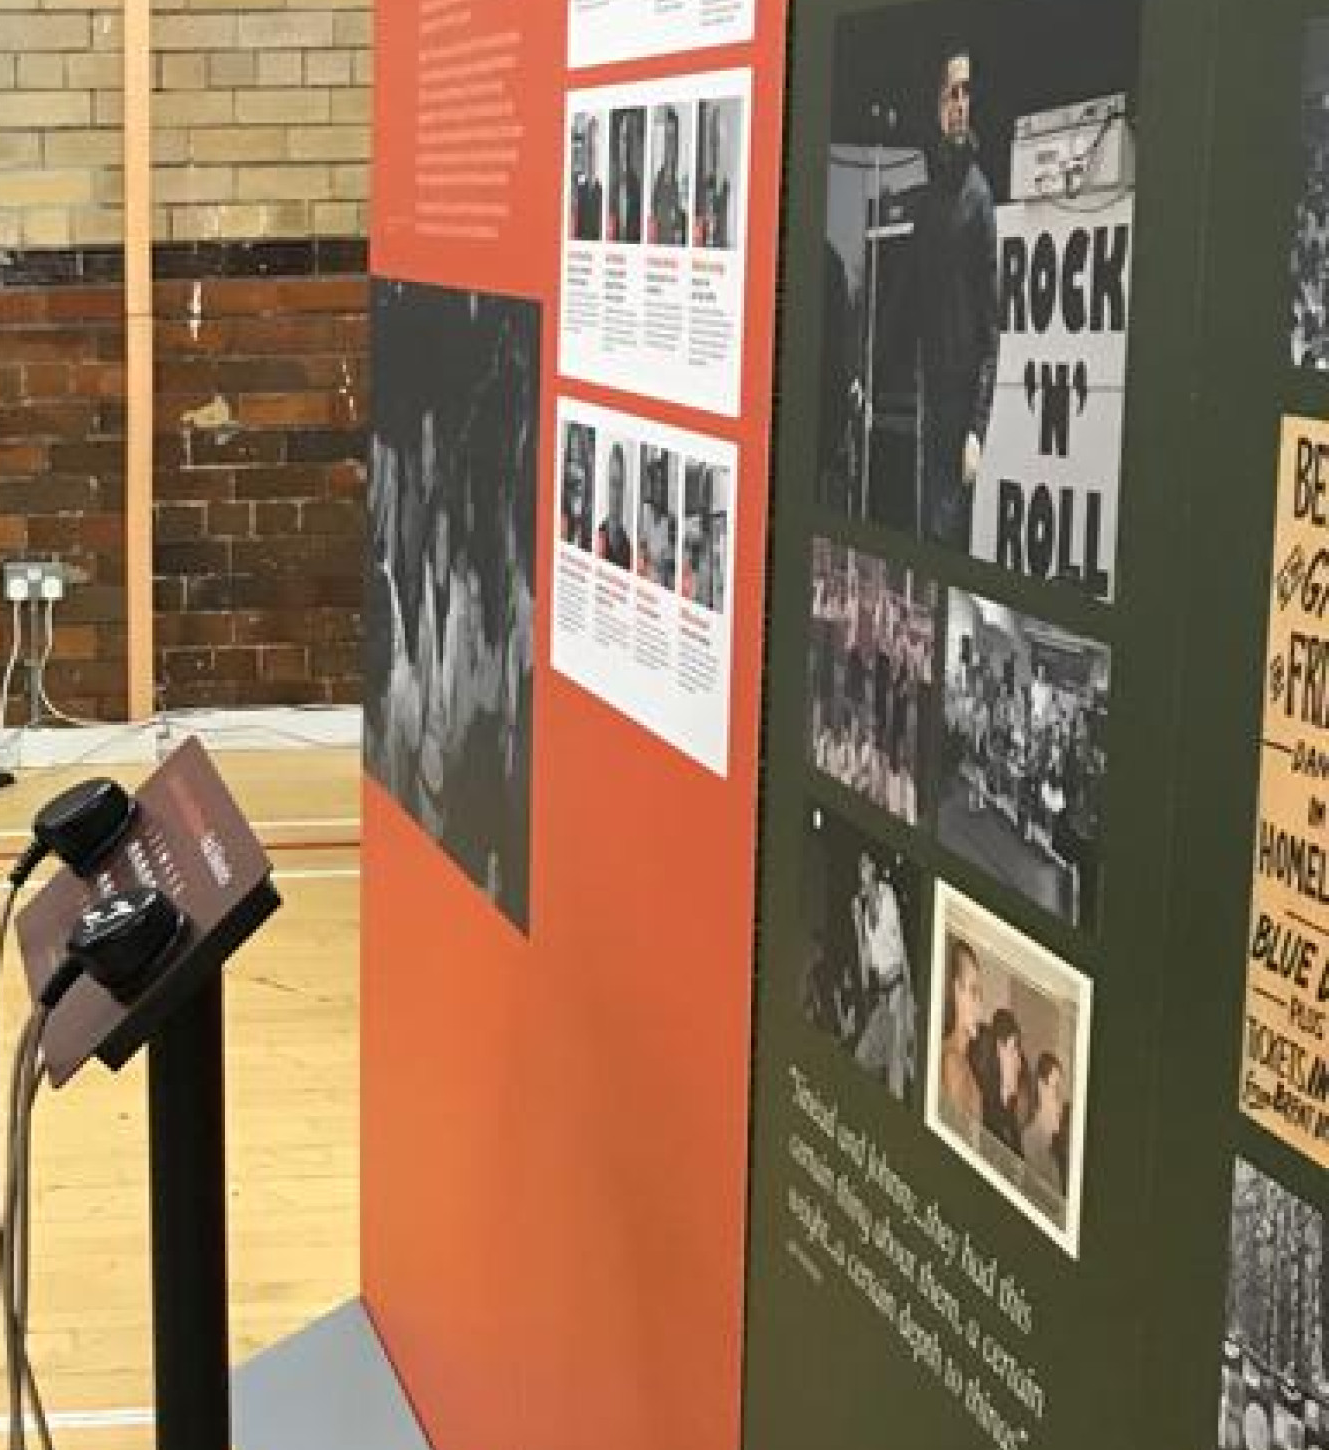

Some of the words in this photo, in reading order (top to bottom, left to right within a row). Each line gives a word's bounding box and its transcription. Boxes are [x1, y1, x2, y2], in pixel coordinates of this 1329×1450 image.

[1000, 225, 1130, 334] ROCK
[1023, 359, 1088, 457] 'N'
[996, 478, 1108, 597] ROLL
[1253, 913, 1319, 989] BLUE
[962, 1233, 997, 1297] had
[999, 1273, 1032, 1334] this
[982, 1334, 1043, 1418] certain
